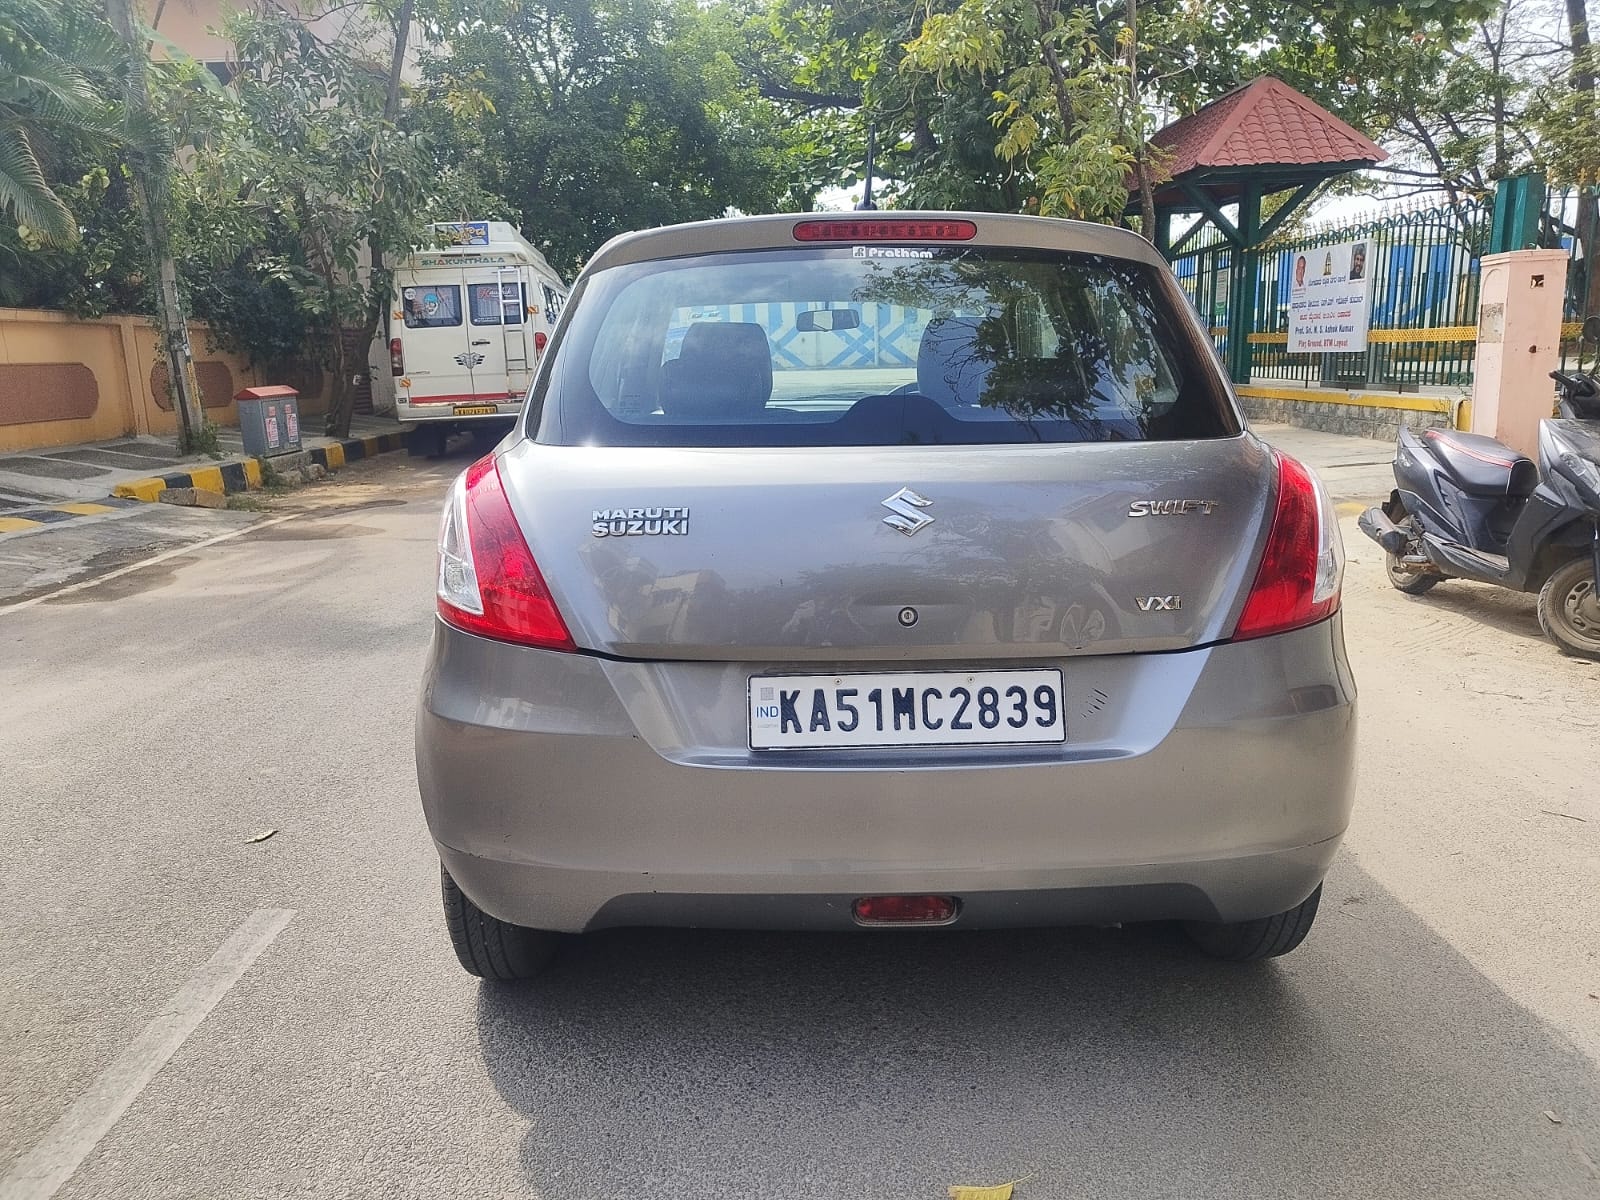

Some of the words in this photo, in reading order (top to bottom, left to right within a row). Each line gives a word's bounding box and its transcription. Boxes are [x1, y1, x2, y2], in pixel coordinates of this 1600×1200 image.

[868, 247, 933, 259] Pratham
[421, 256, 505, 267] SHAKUNTHALA
[1339, 324, 1354, 333] Kumar
[1324, 338, 1333, 347] BTM
[1334, 339, 1348, 349] Layout
[592, 507, 689, 521] MARUTI
[1128, 500, 1218, 517] SWIFT
[592, 520, 688, 537] SUZUKI
[756, 706, 779, 718] IND
[779, 685, 1057, 734] KA51MC2839
